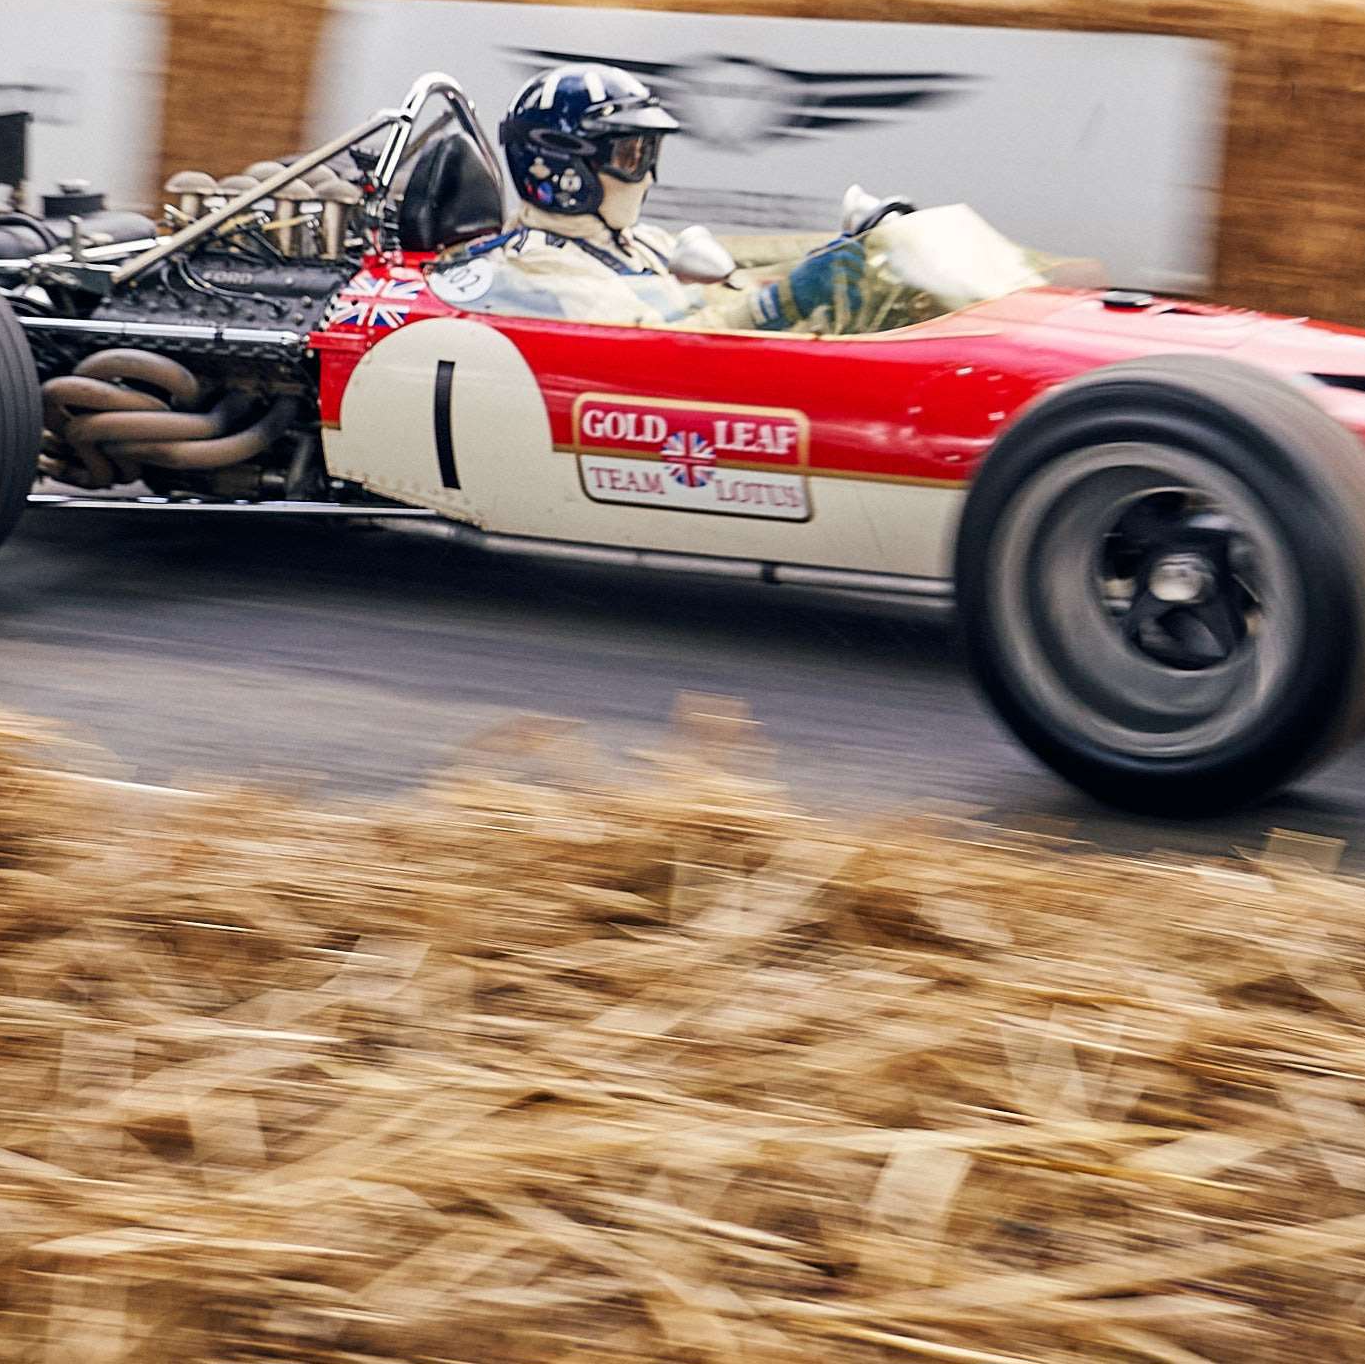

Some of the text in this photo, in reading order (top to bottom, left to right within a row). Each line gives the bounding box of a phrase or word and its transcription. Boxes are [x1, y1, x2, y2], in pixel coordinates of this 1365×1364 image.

[434, 359, 462, 490] 1
[582, 408, 798, 455] GOLD LEAF
[589, 466, 802, 508] TEAM LOTUS
